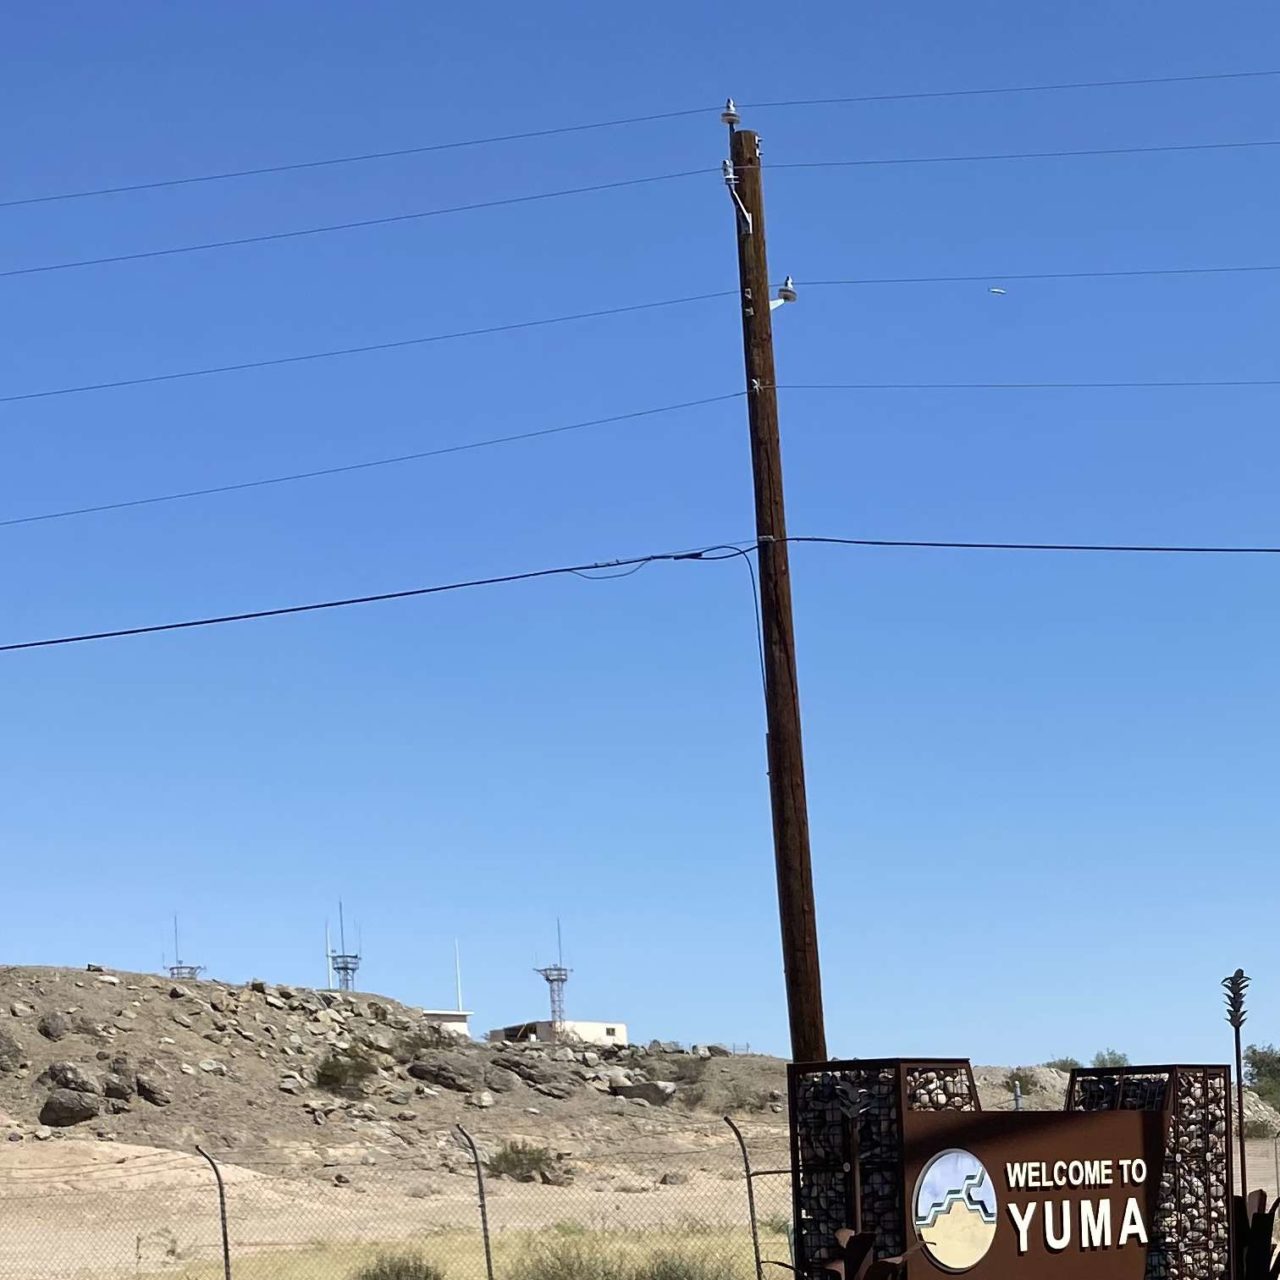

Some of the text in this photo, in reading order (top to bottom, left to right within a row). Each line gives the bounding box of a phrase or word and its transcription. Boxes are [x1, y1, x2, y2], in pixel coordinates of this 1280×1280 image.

[1006, 1158, 1147, 1188] WELCOME TO
[1007, 1197, 1149, 1252] YUMA
